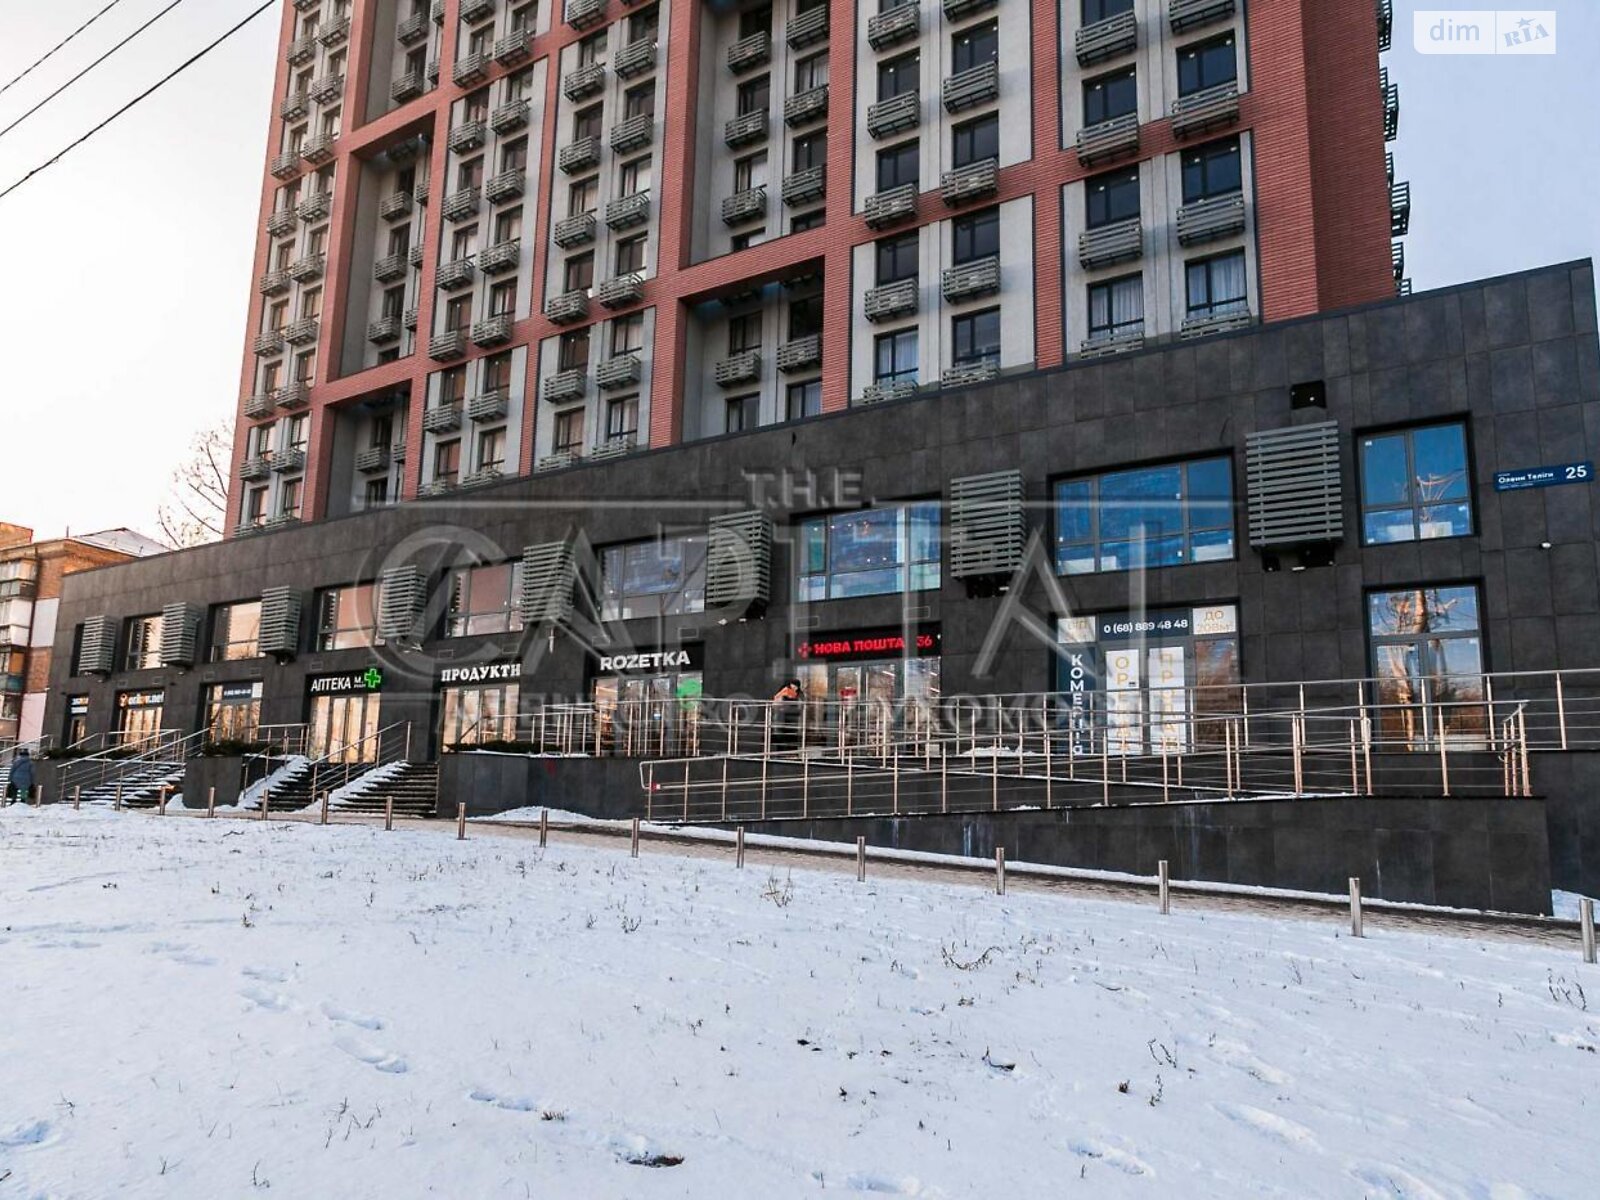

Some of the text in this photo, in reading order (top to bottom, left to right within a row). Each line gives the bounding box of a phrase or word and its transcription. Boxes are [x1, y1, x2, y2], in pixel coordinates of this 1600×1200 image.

[1565, 465, 1588, 480] 25
[1103, 619, 1188, 635] 0 (68) 889 48 48
[814, 641, 851, 654] НОВА
[853, 637, 905, 651] ПОШТА
[600, 649, 690, 671] ROZETKA
[441, 663, 521, 682] ПРОДУКТИ
[311, 676, 351, 692] АПТЕКА
